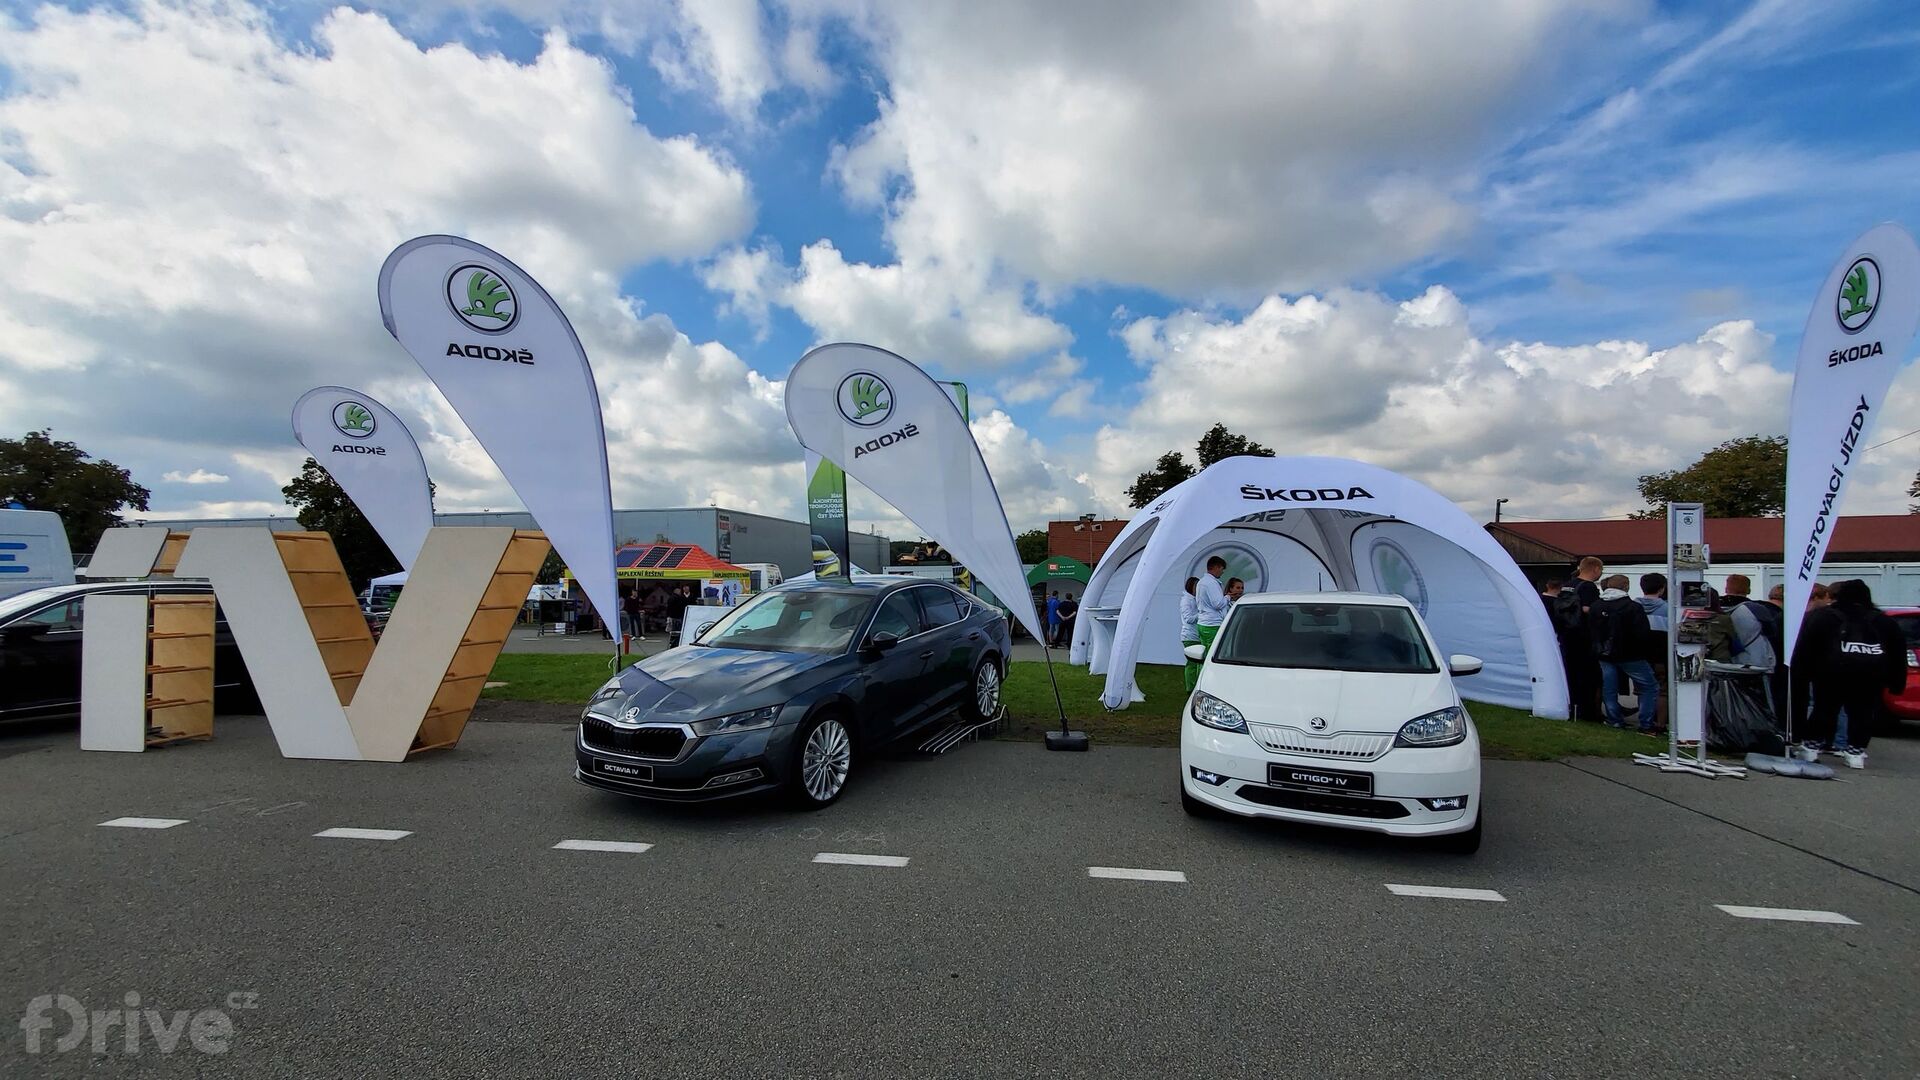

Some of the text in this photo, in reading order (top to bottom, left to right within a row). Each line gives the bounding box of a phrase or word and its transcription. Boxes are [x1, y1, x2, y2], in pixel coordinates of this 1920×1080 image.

[1828, 341, 1884, 368] ŠKODA
[1240, 484, 1375, 502] ŠKODA
[1798, 394, 1871, 582] TESTOVACÍ JÍZDY
[1841, 640, 1883, 655] VANS
[604, 764, 631, 774] OCTAVIA
[1335, 777, 1347, 785] iV
